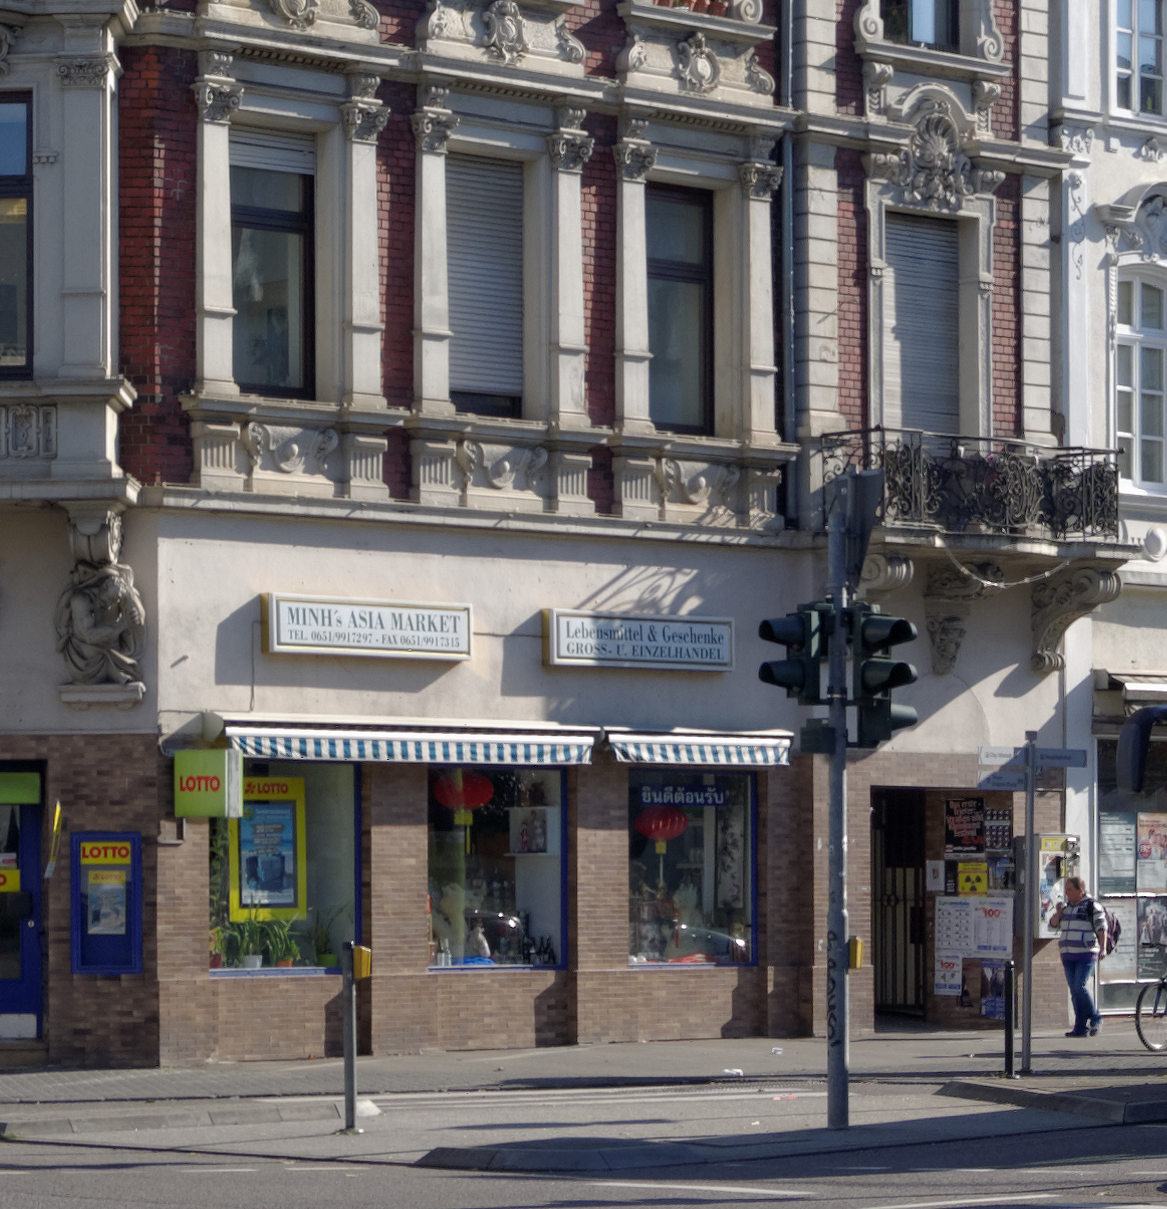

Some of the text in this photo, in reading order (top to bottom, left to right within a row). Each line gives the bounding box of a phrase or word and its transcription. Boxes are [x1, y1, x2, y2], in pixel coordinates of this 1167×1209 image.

[348, 610, 385, 631] ASIA
[391, 612, 461, 634] MARKET
[288, 629, 309, 641] TEL.
[311, 630, 373, 644] 0651/9917297
[381, 634, 398, 646] FAX
[400, 634, 460, 648] 0651/9917315
[566, 620, 725, 645] Lebensmittel & Geschenke
[566, 642, 725, 660] GROSS- U. EINZELHANDEL
[179, 775, 221, 792] LOTTO
[257, 783, 289, 794] LOTTO
[82, 846, 130, 859] LOTTO
